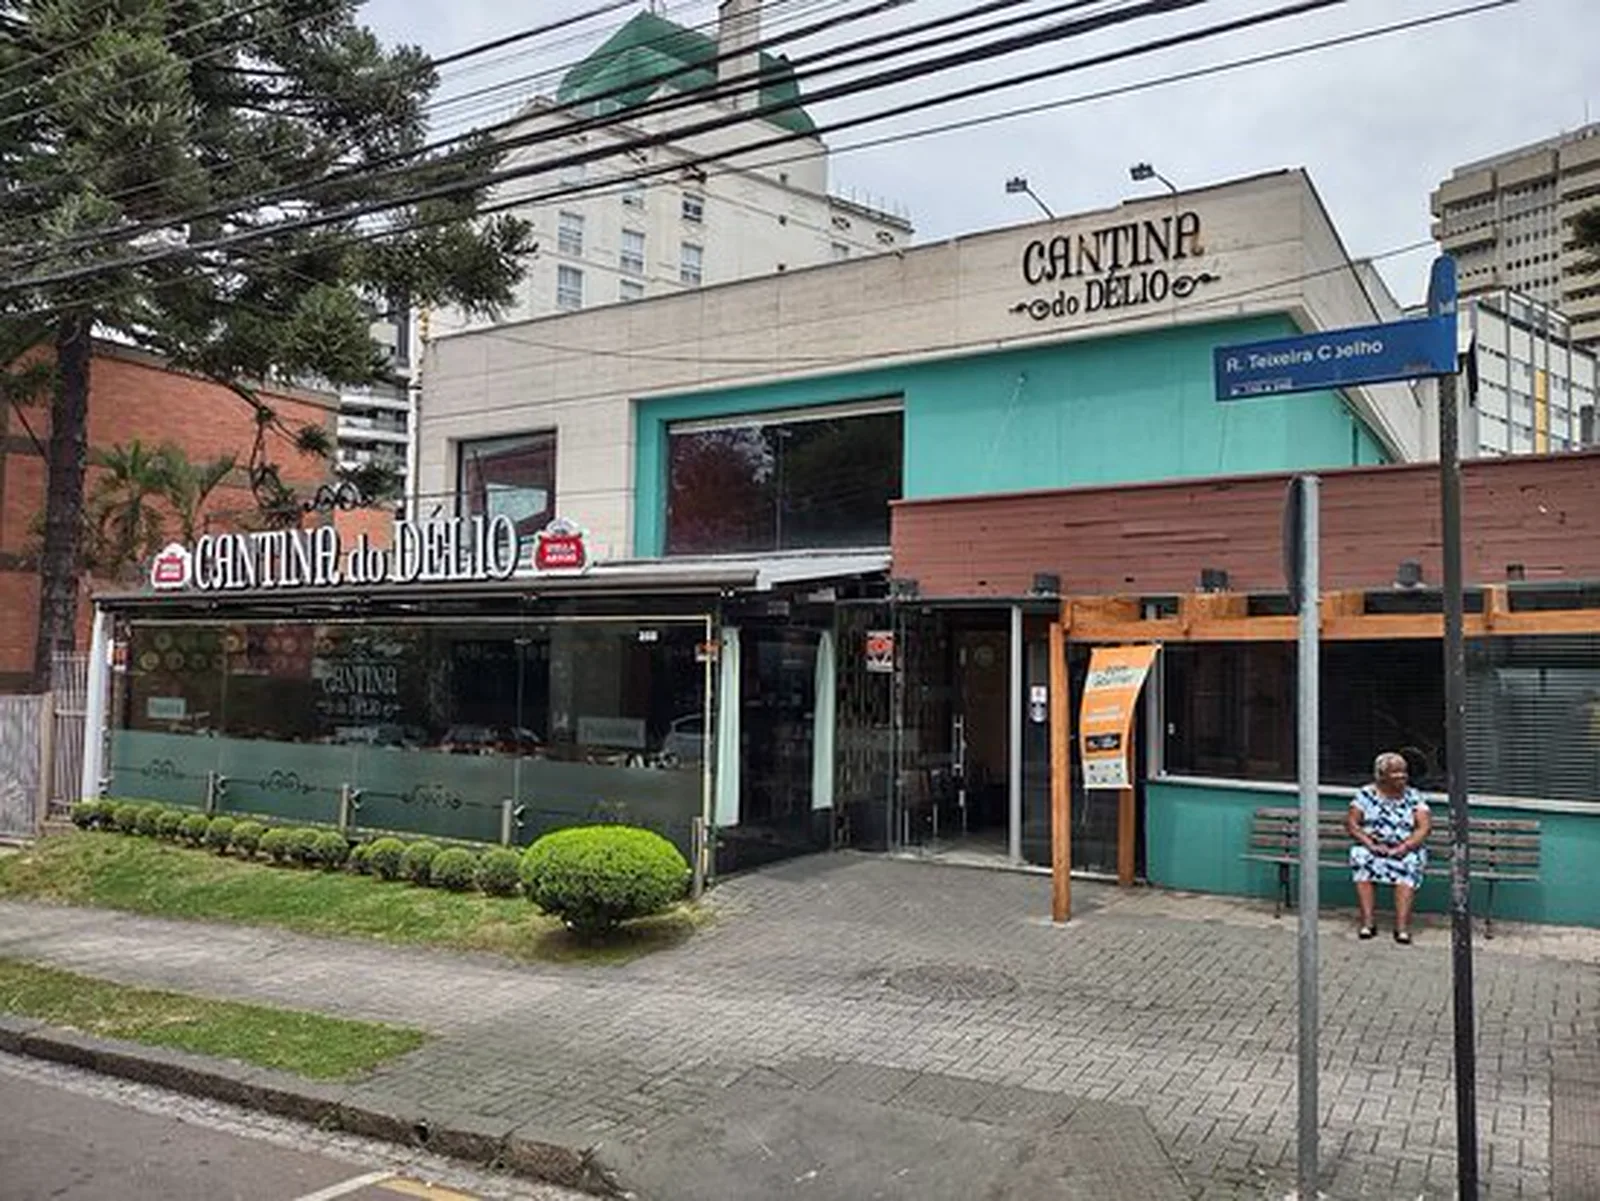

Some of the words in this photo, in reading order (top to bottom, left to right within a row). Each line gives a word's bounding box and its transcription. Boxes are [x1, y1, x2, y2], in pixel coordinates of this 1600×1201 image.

[1022, 211, 1206, 286] CANTINA
[1052, 290, 1079, 317] do
[1084, 267, 1169, 313] DÉLIO
[1226, 357, 1245, 373] R.
[1248, 349, 1313, 369] Teixeira
[195, 525, 341, 590] CANTINA
[348, 533, 387, 584] do
[387, 505, 519, 583] DÉLIO
